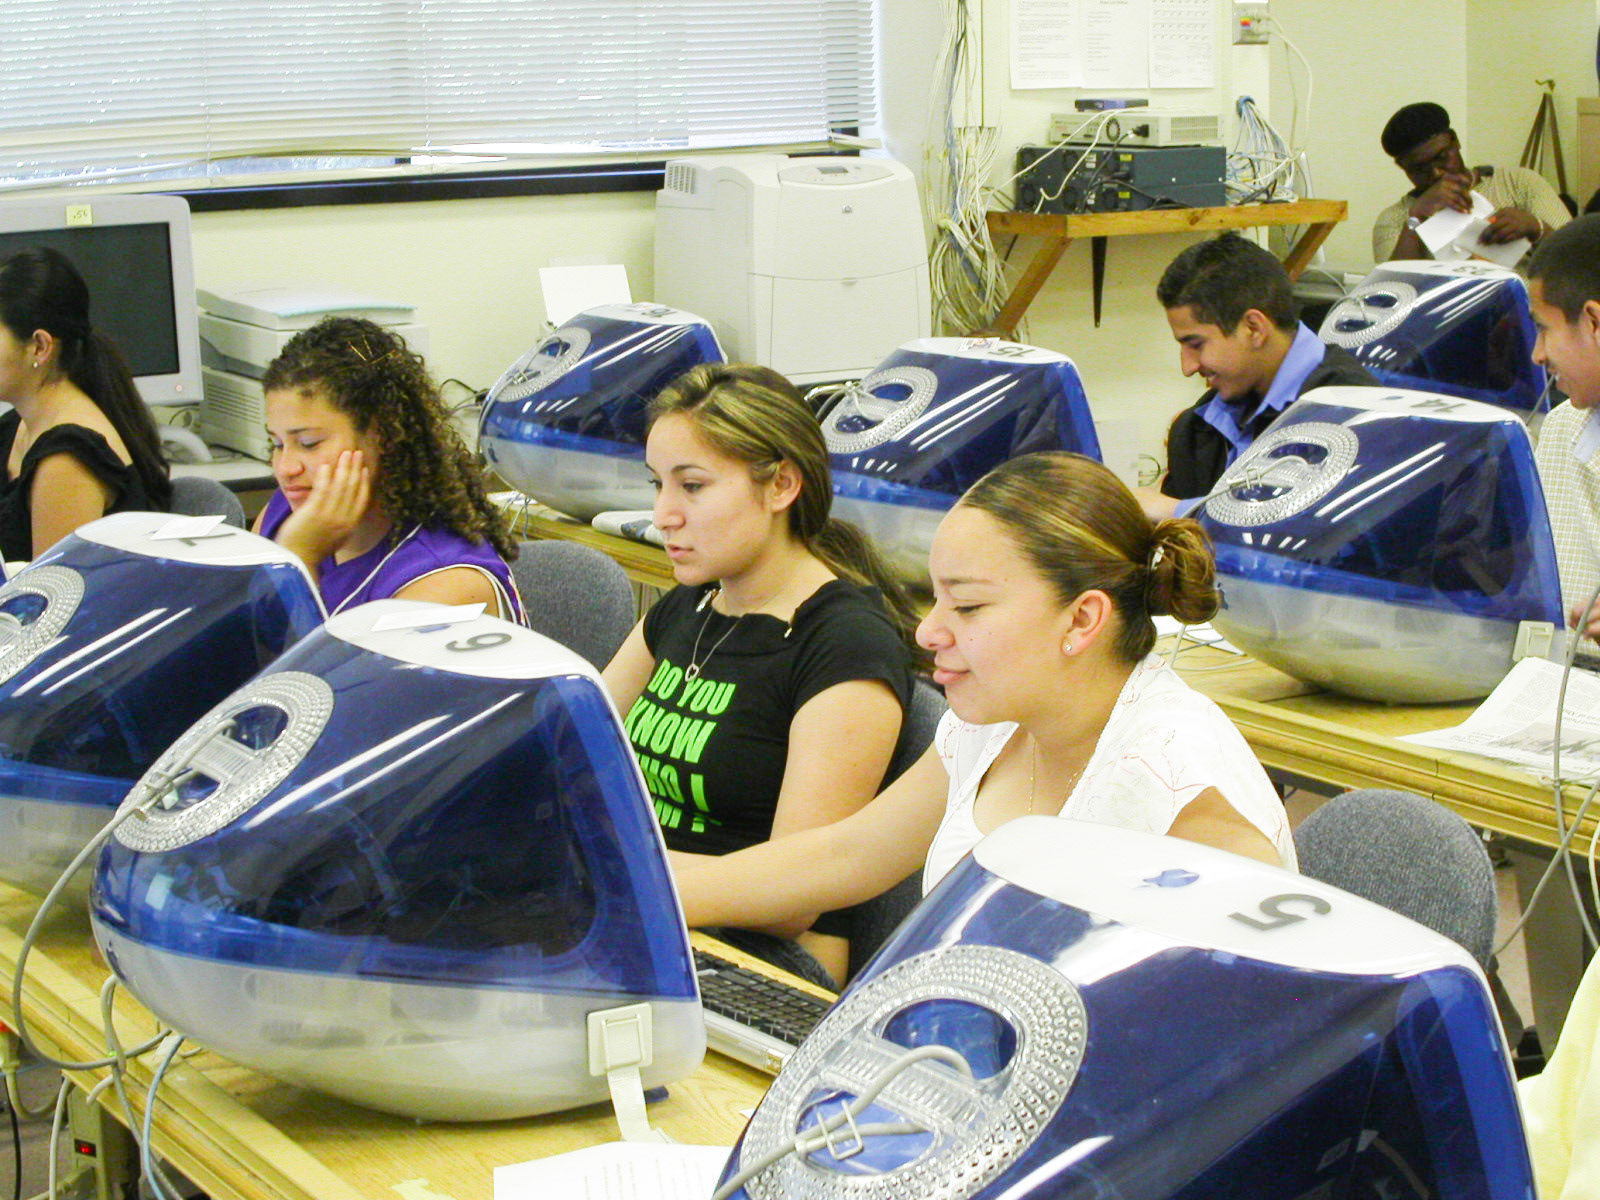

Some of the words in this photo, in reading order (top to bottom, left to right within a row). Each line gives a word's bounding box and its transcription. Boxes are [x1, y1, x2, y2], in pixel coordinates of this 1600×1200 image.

[647, 658, 684, 700] DO
[676, 677, 737, 716] YOU
[624, 695, 718, 764] KNOW
[635, 752, 685, 804] HO
[690, 773, 710, 813] I
[1227, 893, 1332, 932] 5
